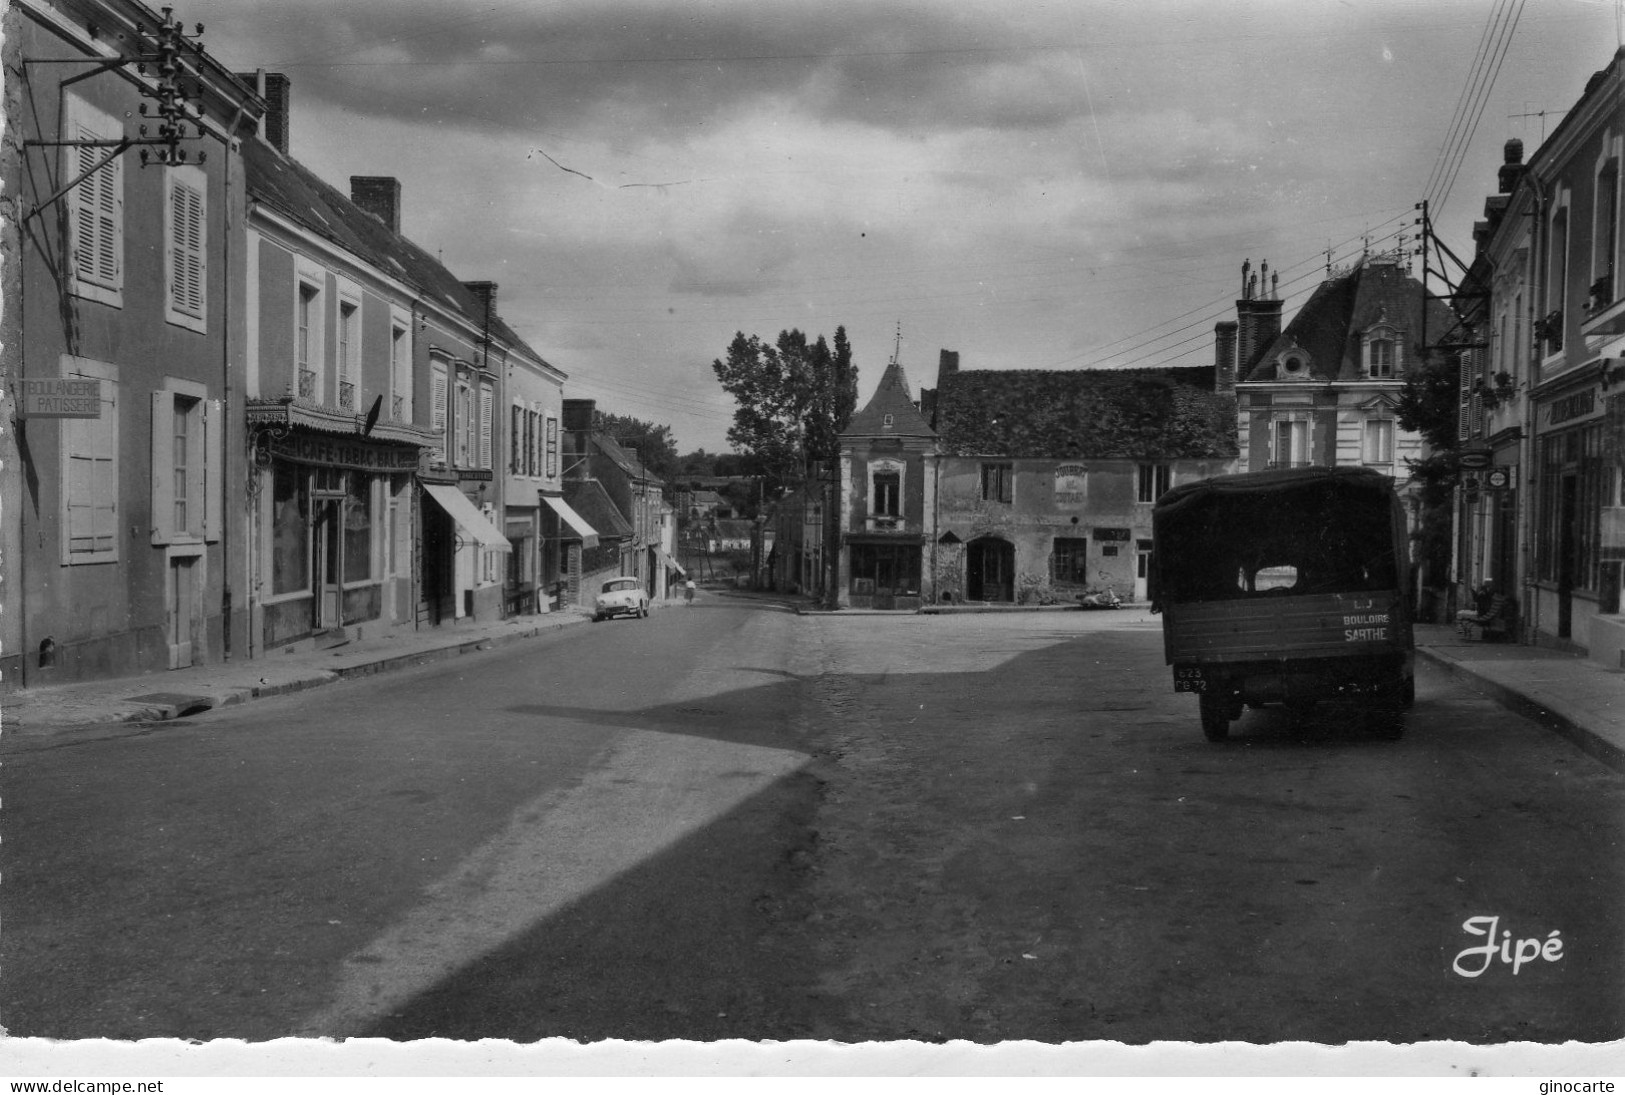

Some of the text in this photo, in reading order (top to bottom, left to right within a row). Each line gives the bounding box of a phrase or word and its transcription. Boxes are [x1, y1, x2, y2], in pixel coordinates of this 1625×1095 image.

[29, 380, 100, 396] BOULANGERIE
[38, 397, 101, 412] PATISSERIE
[1343, 615, 1389, 625] BOULOIRE
[1345, 628, 1387, 641] SARTHE
